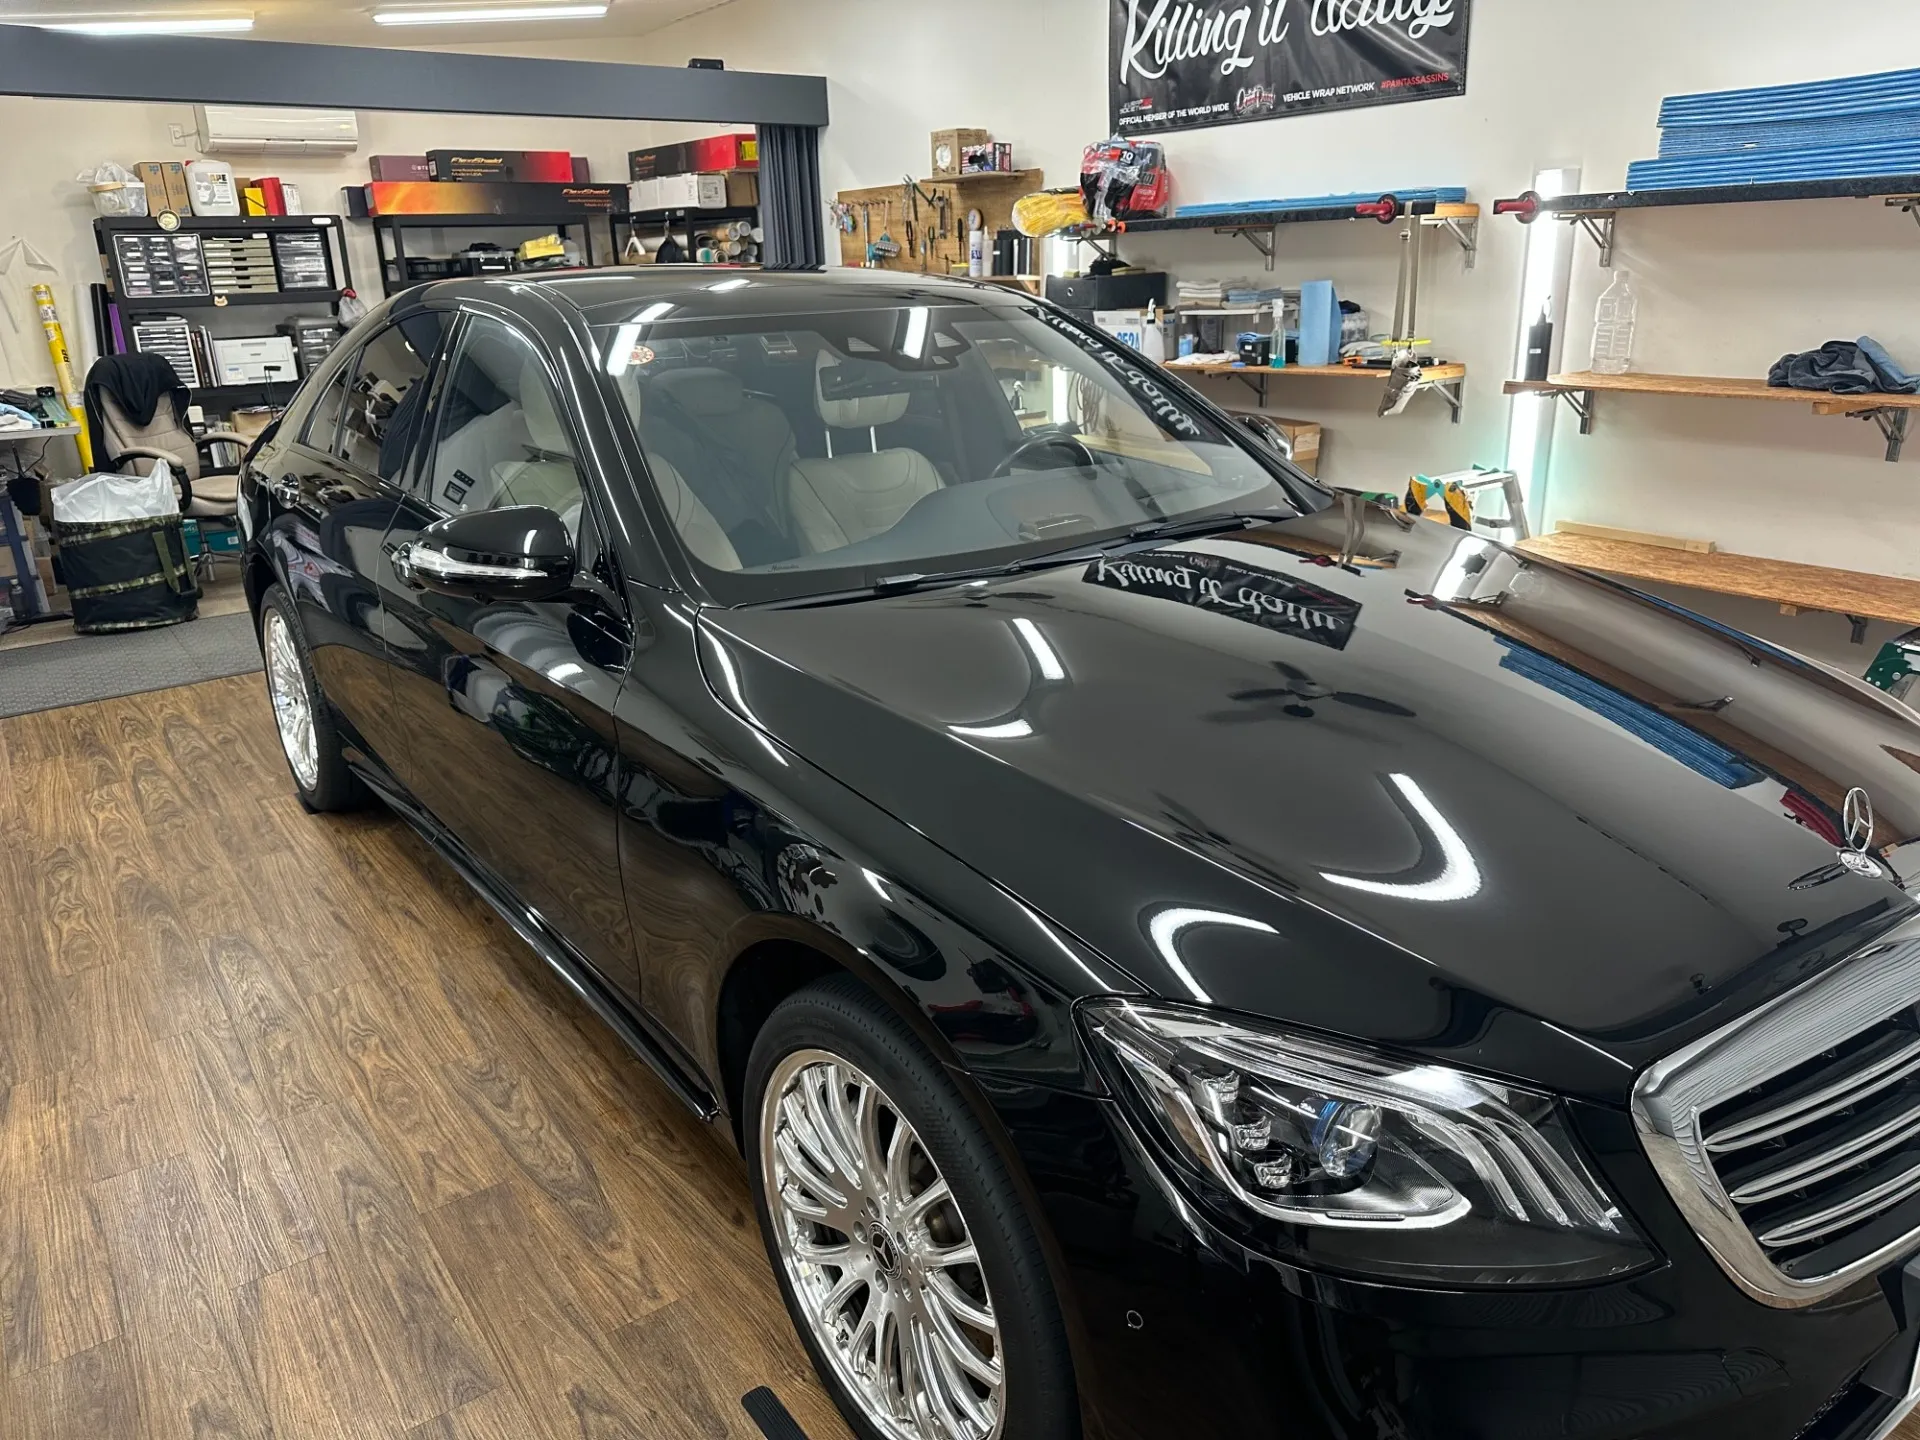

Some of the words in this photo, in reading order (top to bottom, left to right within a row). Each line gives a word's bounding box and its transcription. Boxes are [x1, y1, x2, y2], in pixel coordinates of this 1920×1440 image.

[1120, 0, 1255, 85] Killing
[1118, 116, 1143, 125] OFFICIAL
[1143, 112, 1167, 121] MEMBER
[1168, 111, 1175, 119] OF
[1176, 109, 1188, 117] THE
[1188, 105, 1211, 115] WORLD
[1212, 102, 1230, 113] WIDE
[1283, 91, 1311, 102] VEHICLE
[1311, 87, 1334, 98] WRAP
[1336, 82, 1376, 96] NETWORK
[1381, 72, 1449, 89] #PAINTASSASSINS
[1121, 150, 1134, 161] 10
